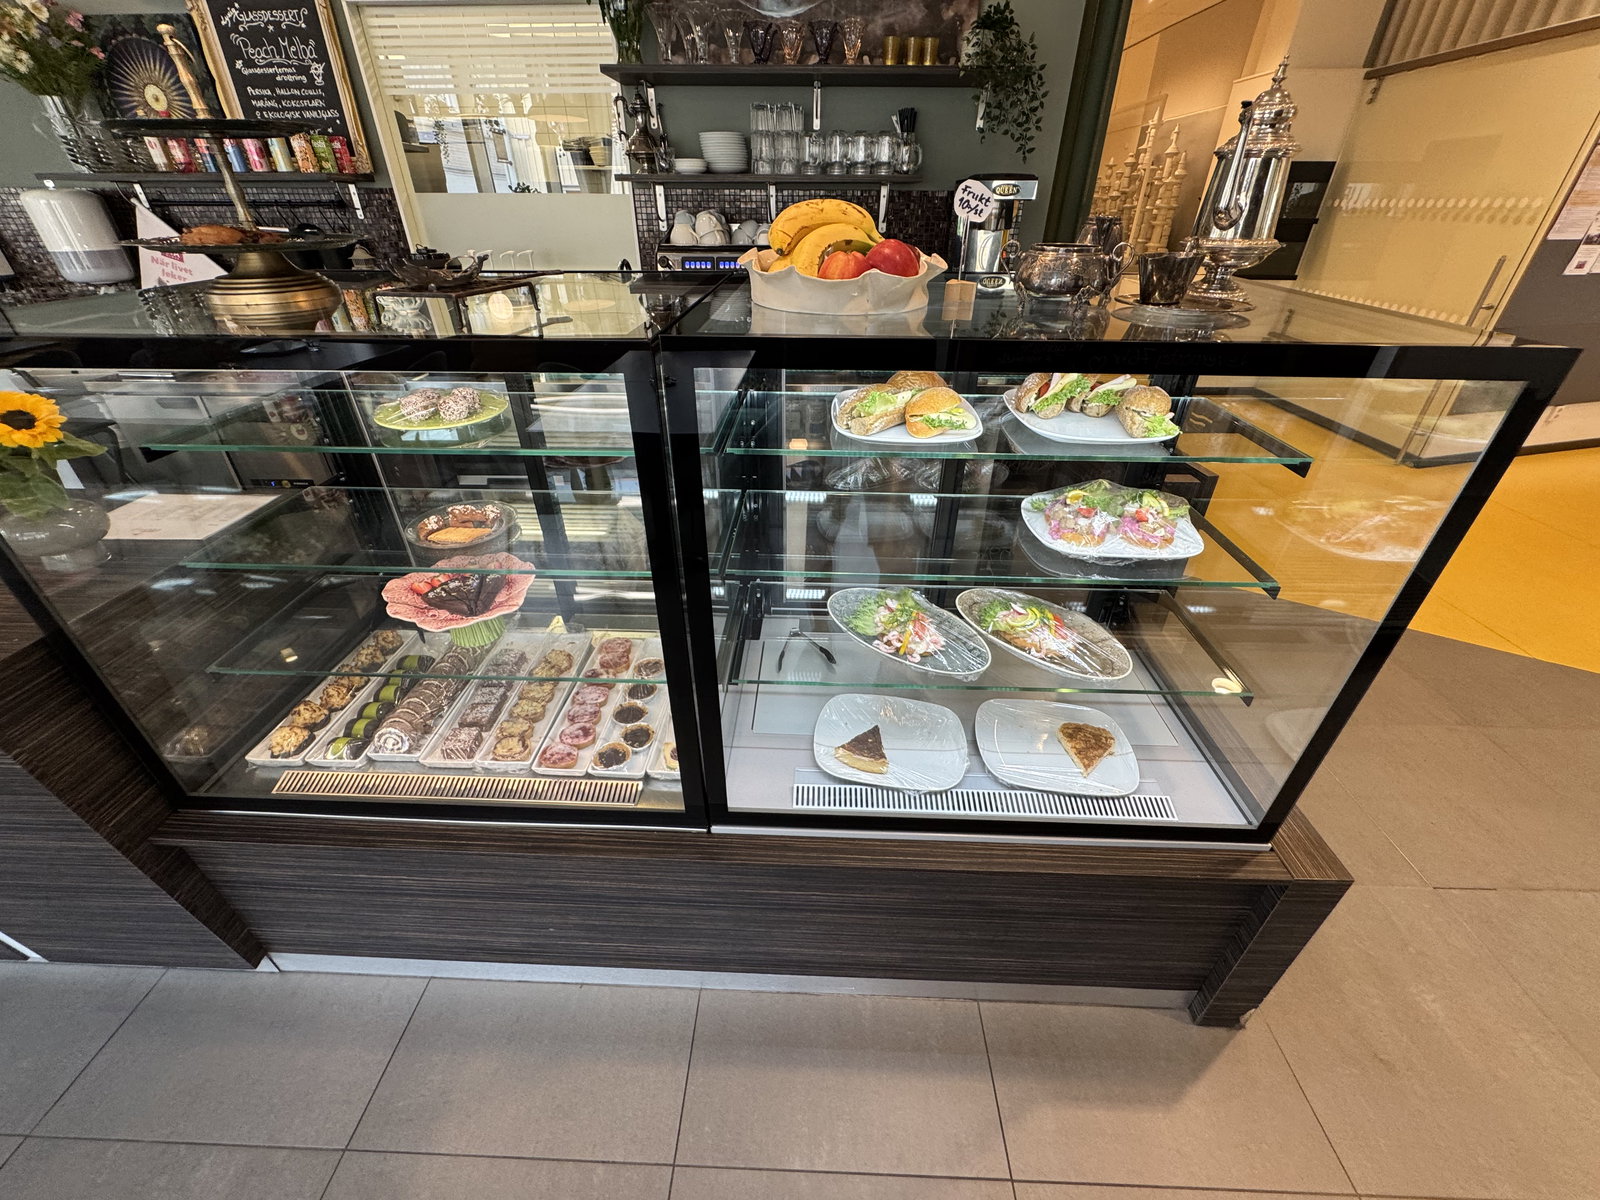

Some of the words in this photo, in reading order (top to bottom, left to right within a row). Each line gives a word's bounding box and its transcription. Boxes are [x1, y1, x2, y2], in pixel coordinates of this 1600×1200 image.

[263, 111, 301, 119] EKOLOGISK
[961, 184, 991, 207] Frukt
[995, 186, 1018, 195] QUEEN
[151, 256, 170, 267] När
[171, 261, 193, 276] livet
